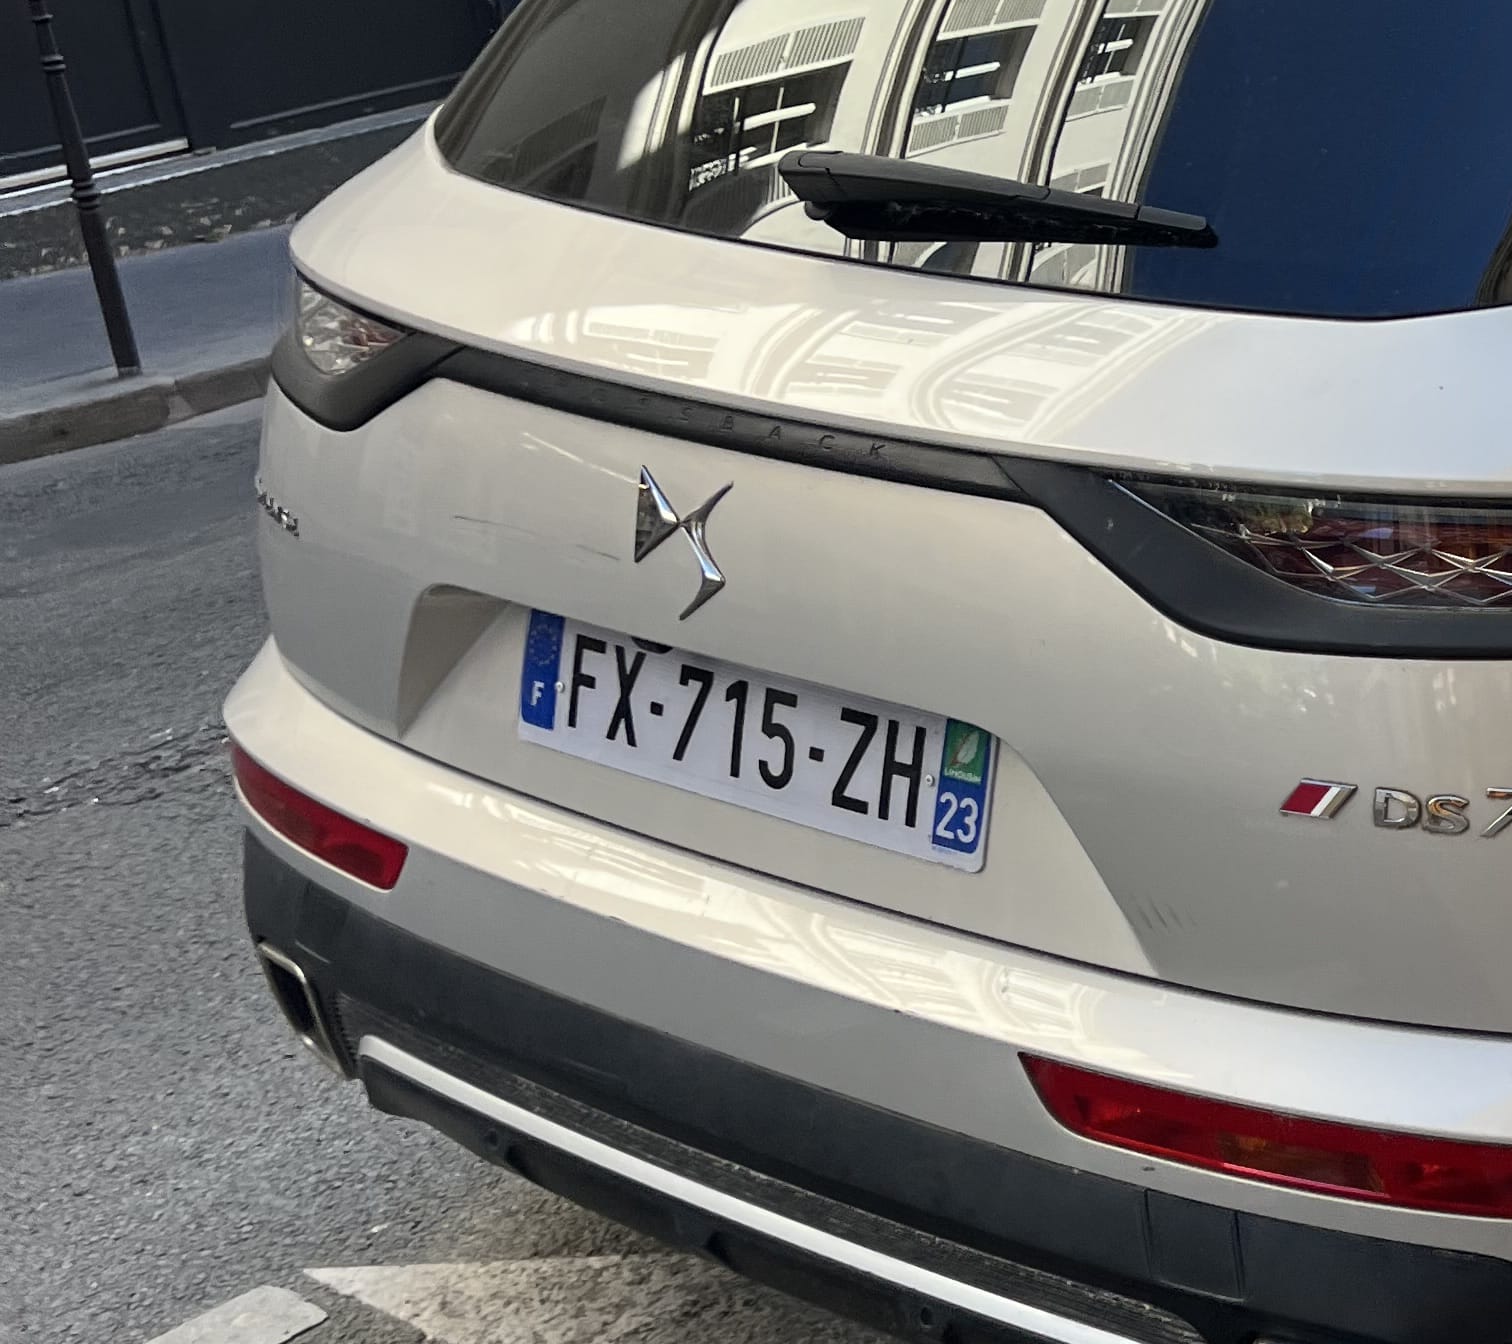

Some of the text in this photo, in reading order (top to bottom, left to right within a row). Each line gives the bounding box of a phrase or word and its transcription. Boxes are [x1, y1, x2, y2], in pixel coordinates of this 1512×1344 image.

[530, 680, 545, 707] F
[567, 634, 927, 828] FX-715-ZH
[936, 791, 979, 844] 23
[1372, 786, 1471, 835] DS
